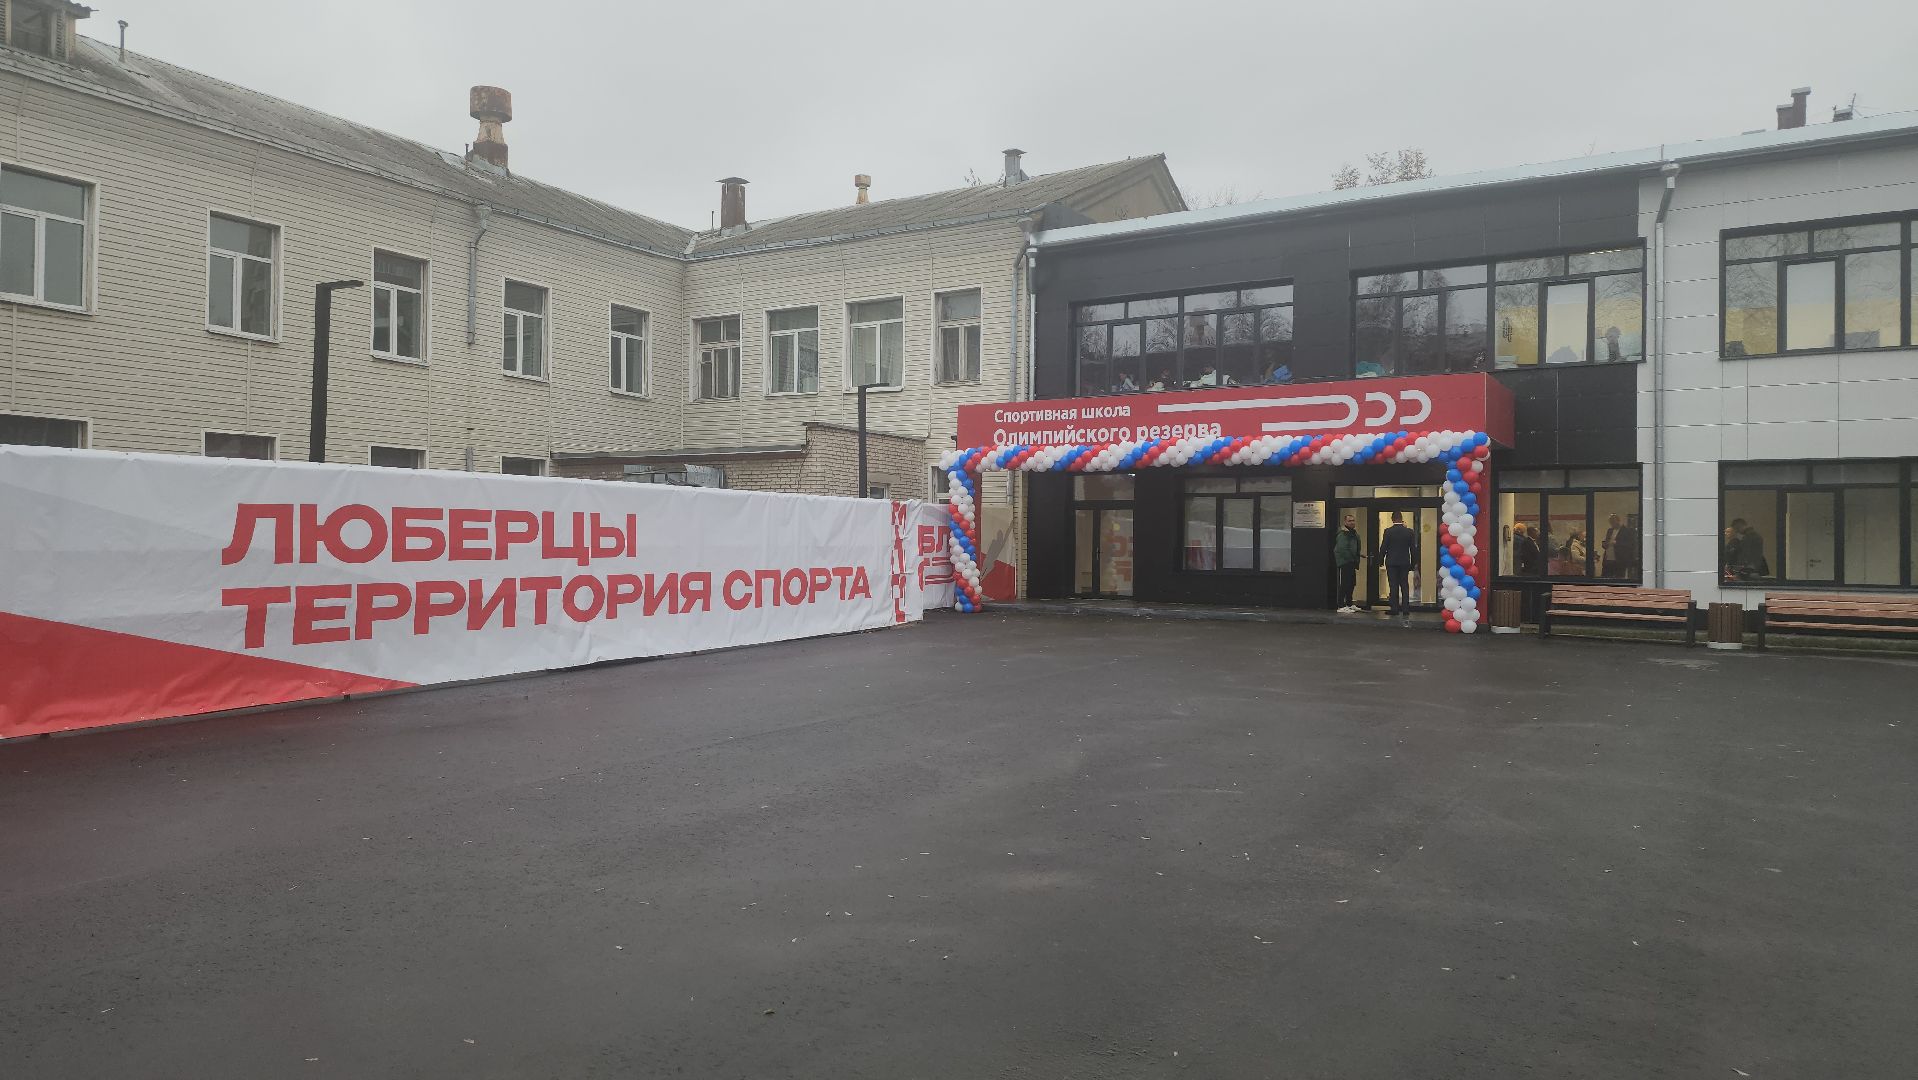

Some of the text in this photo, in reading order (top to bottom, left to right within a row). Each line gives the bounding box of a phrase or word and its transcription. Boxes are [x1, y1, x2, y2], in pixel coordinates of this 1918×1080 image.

[993, 421, 1222, 447] Олимпийского резерва
[994, 404, 1131, 424] Спортивная школа
[221, 503, 637, 567] ЛЮБЕРЦЫ
[221, 566, 872, 650] ТЕРРИТОРИЯ СПОРТА
